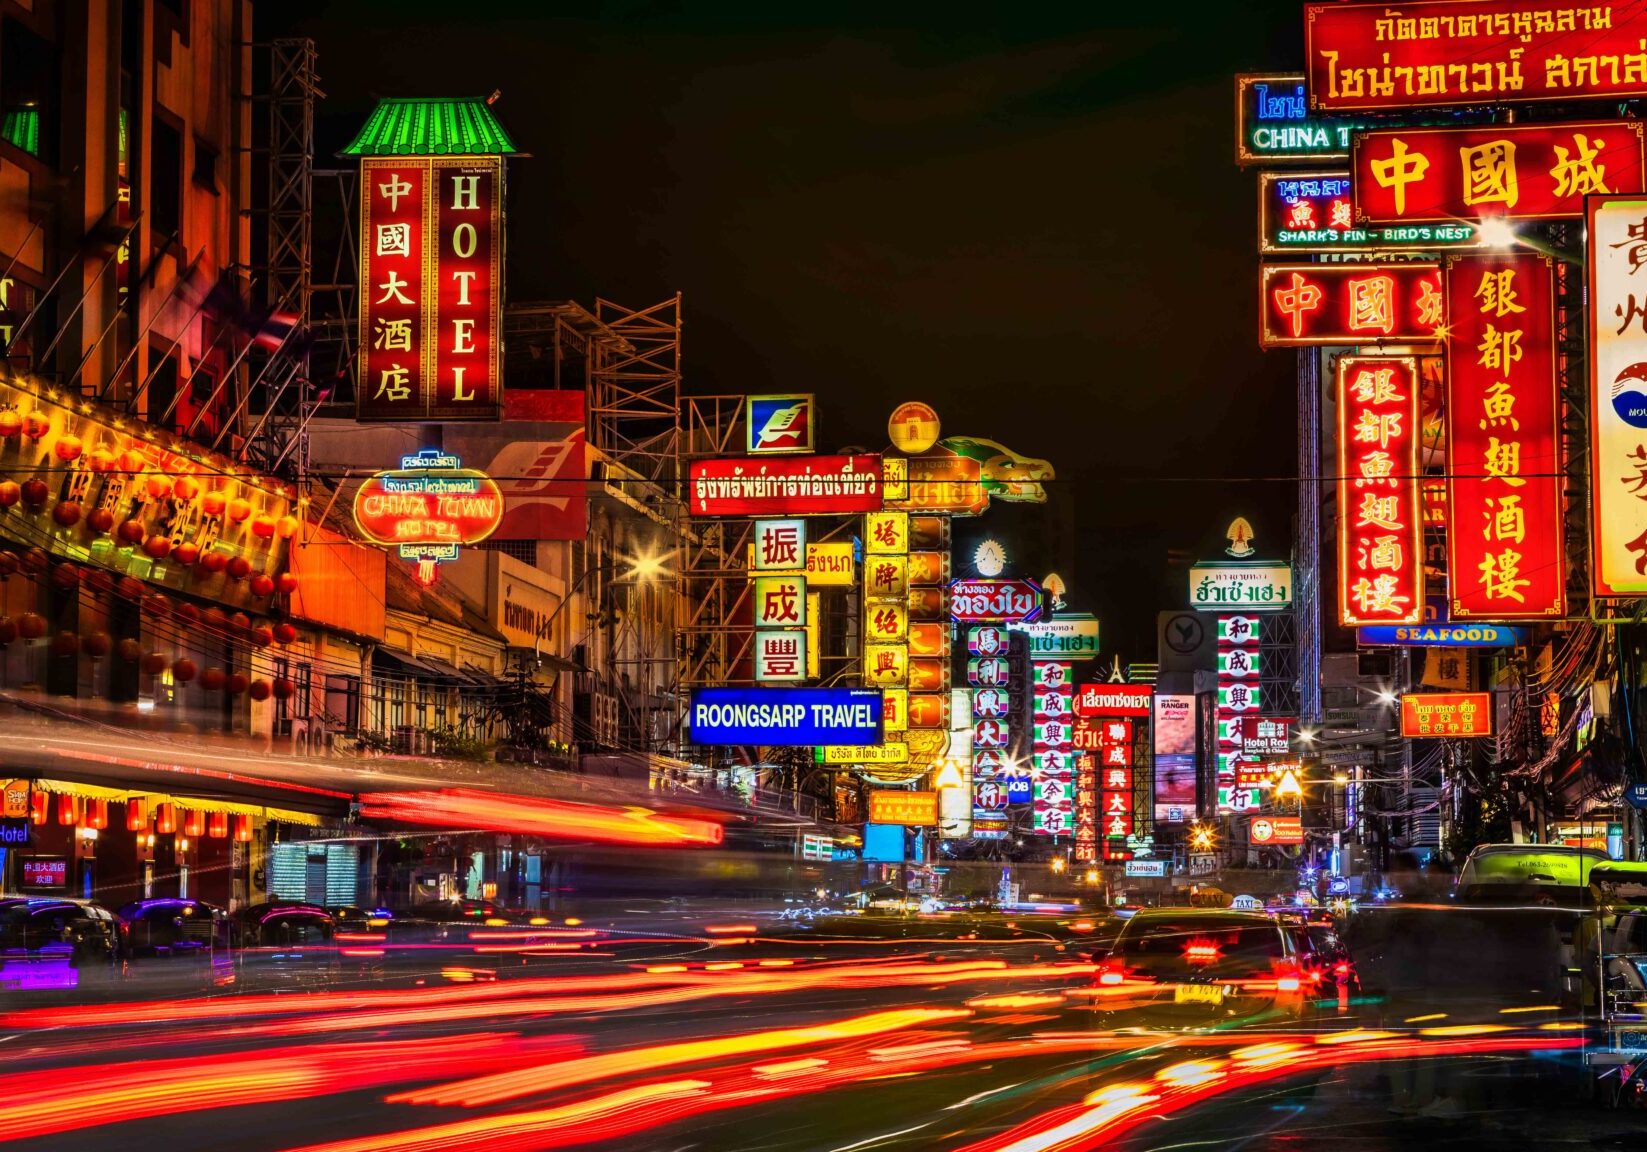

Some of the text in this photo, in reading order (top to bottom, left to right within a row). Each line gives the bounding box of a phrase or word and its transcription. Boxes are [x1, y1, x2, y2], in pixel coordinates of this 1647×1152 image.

[1320, 48, 1524, 98] ไชน่าทาวน์
[1254, 128, 1329, 148] CHINA
[1370, 134, 1609, 215] 中國城
[1279, 229, 1338, 242] SHARK'S
[1343, 230, 1366, 241] FIN
[1384, 227, 1431, 241] BIRD'S
[1435, 226, 1472, 239] NEST
[374, 173, 416, 402] 中國大酒店
[451, 176, 480, 401] HOTEL
[1473, 269, 1531, 604] 銀都魚翅酒樓
[696, 456, 876, 511] รุ่งทรัพย์การท่องเที่ยว
[364, 495, 495, 517] CHINA TOWN
[762, 528, 798, 676] 振成豐
[1395, 628, 1497, 641] SEAFOOD
[696, 704, 876, 728] ROONGSARP TRAVEL
[1244, 738, 1268, 747] Hotel
[1108, 723, 1127, 857] 聯成興大金
[1201, 893, 1224, 905] TAXI
[1236, 899, 1253, 908] TAXI
